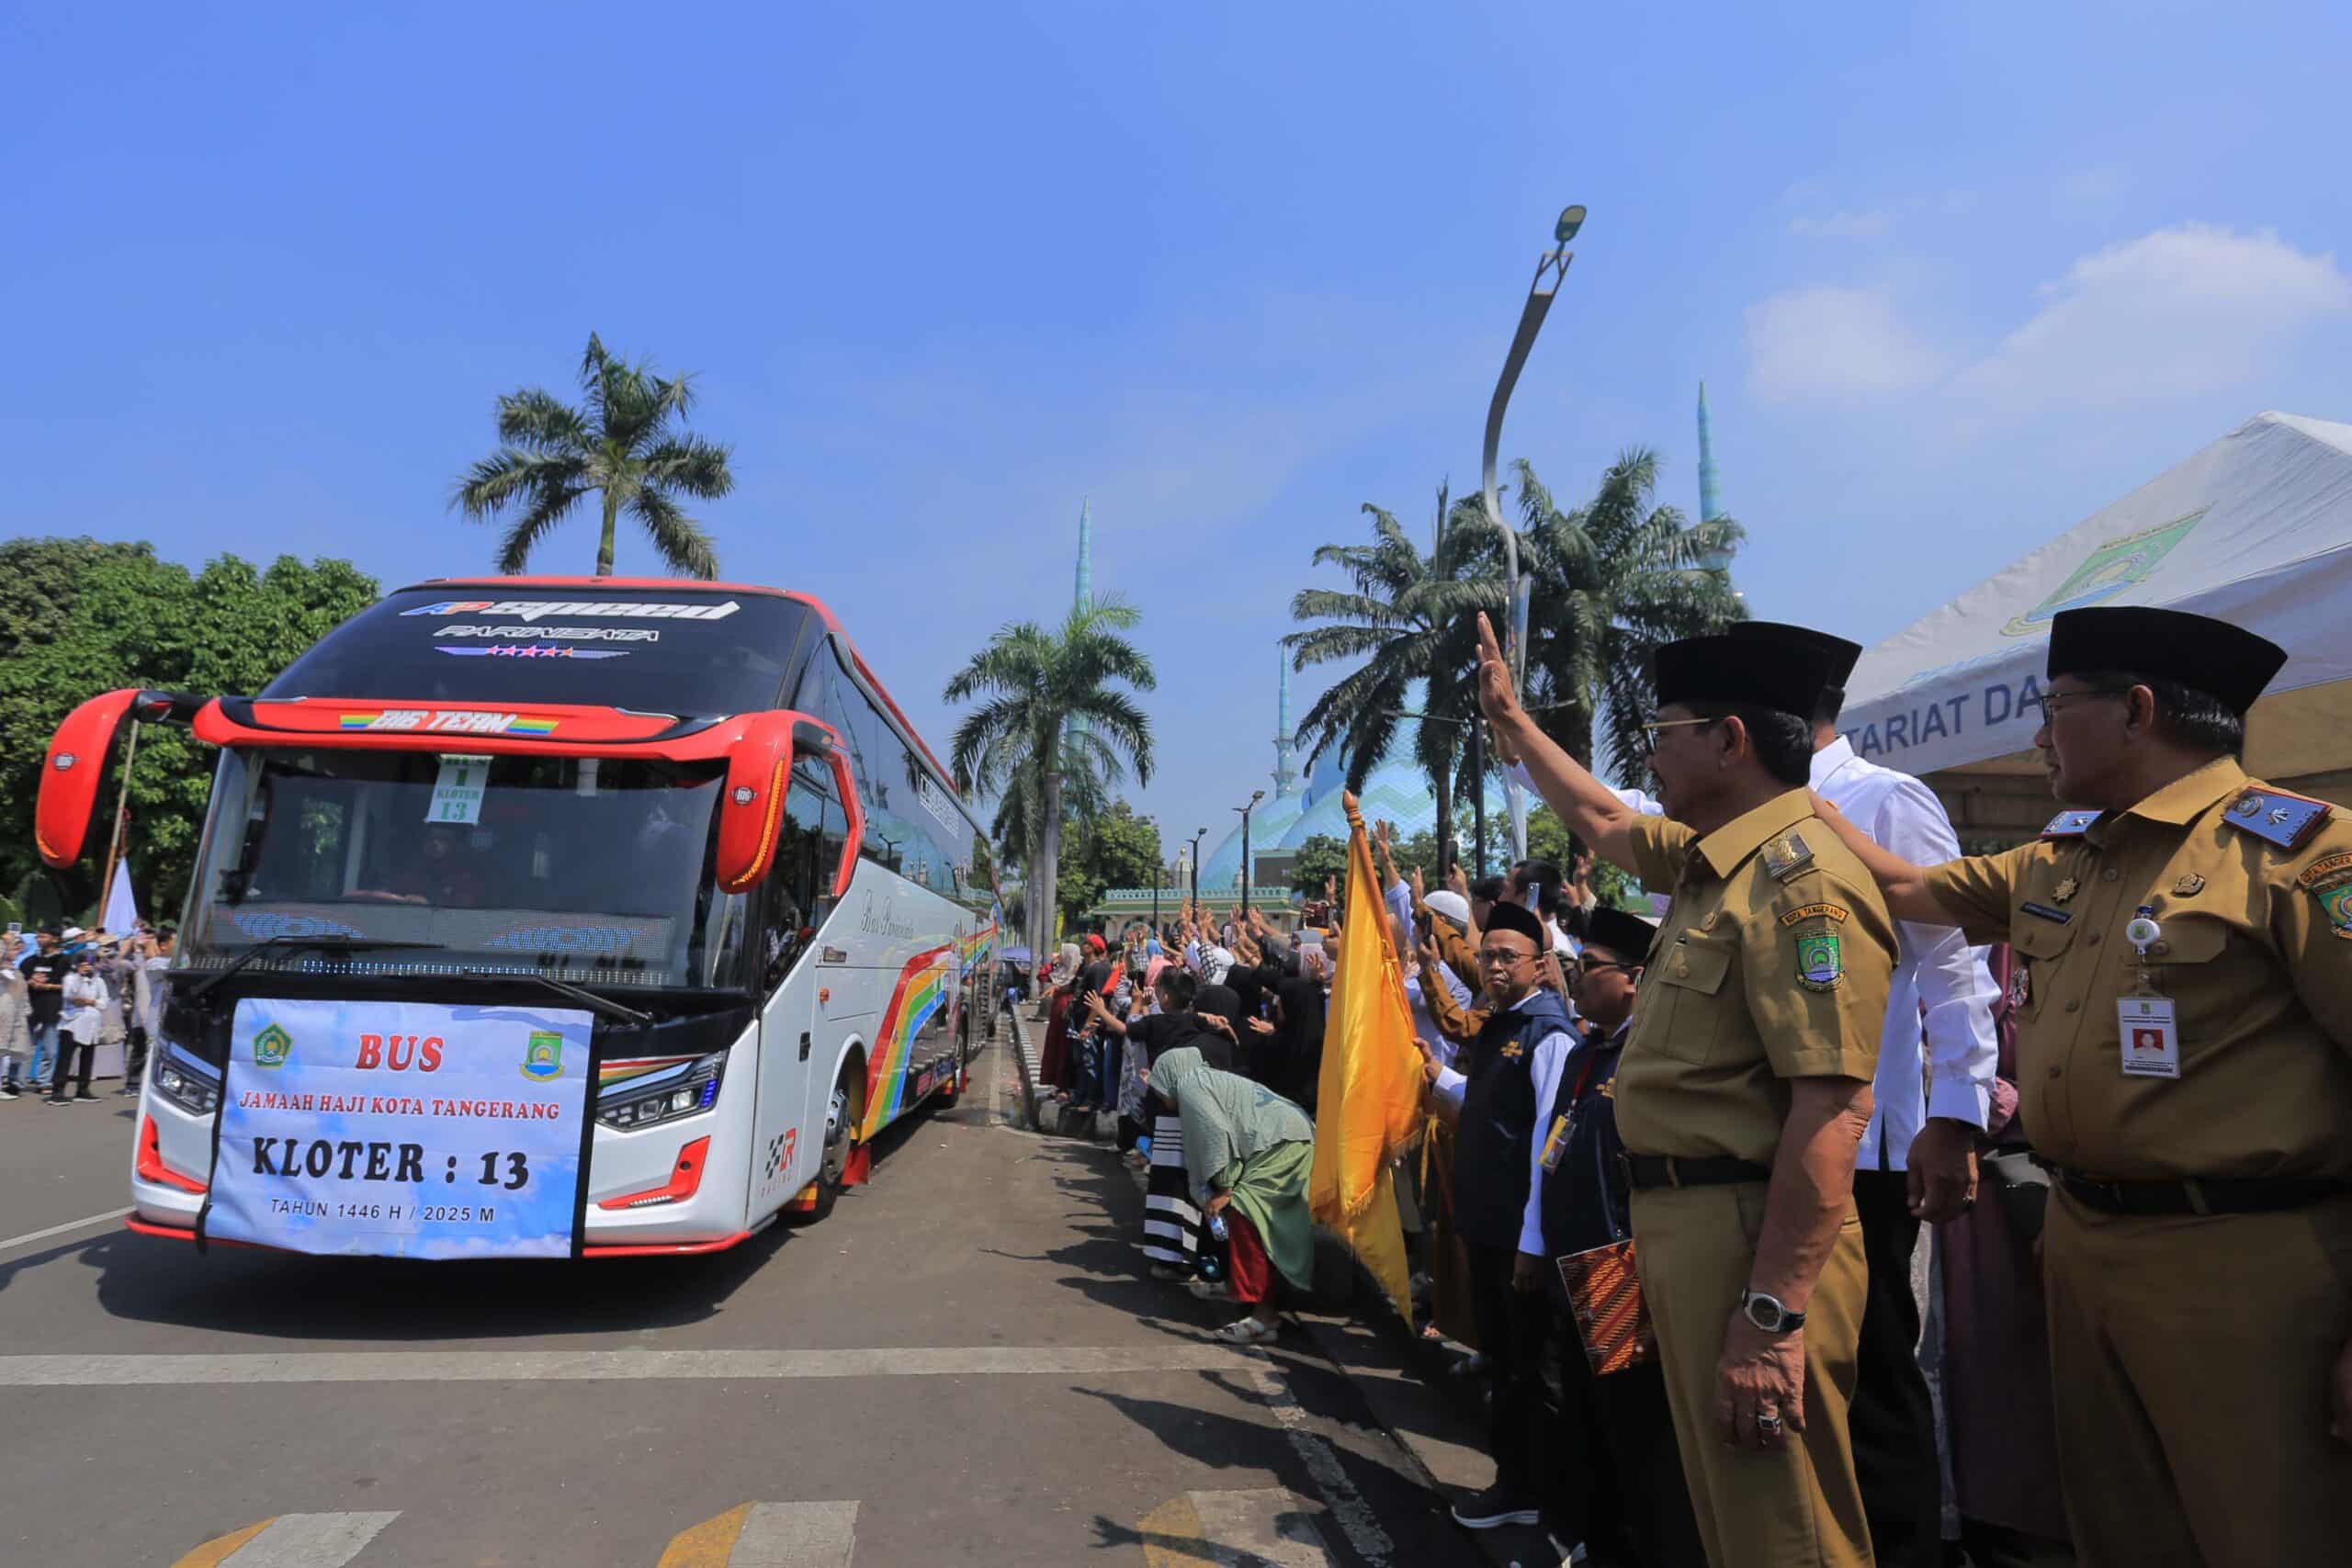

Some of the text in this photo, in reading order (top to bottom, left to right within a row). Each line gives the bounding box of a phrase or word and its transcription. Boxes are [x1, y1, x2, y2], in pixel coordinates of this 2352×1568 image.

[425, 710, 518, 734] TEAM
[356, 1033, 446, 1073] BUS
[239, 1090, 560, 1121] JAMAAH HAJI KOTA TANGERANG
[253, 1136, 530, 1190] KLOTER : 13
[271, 1198, 496, 1223] TAHUN 1446 H / 2025 M
